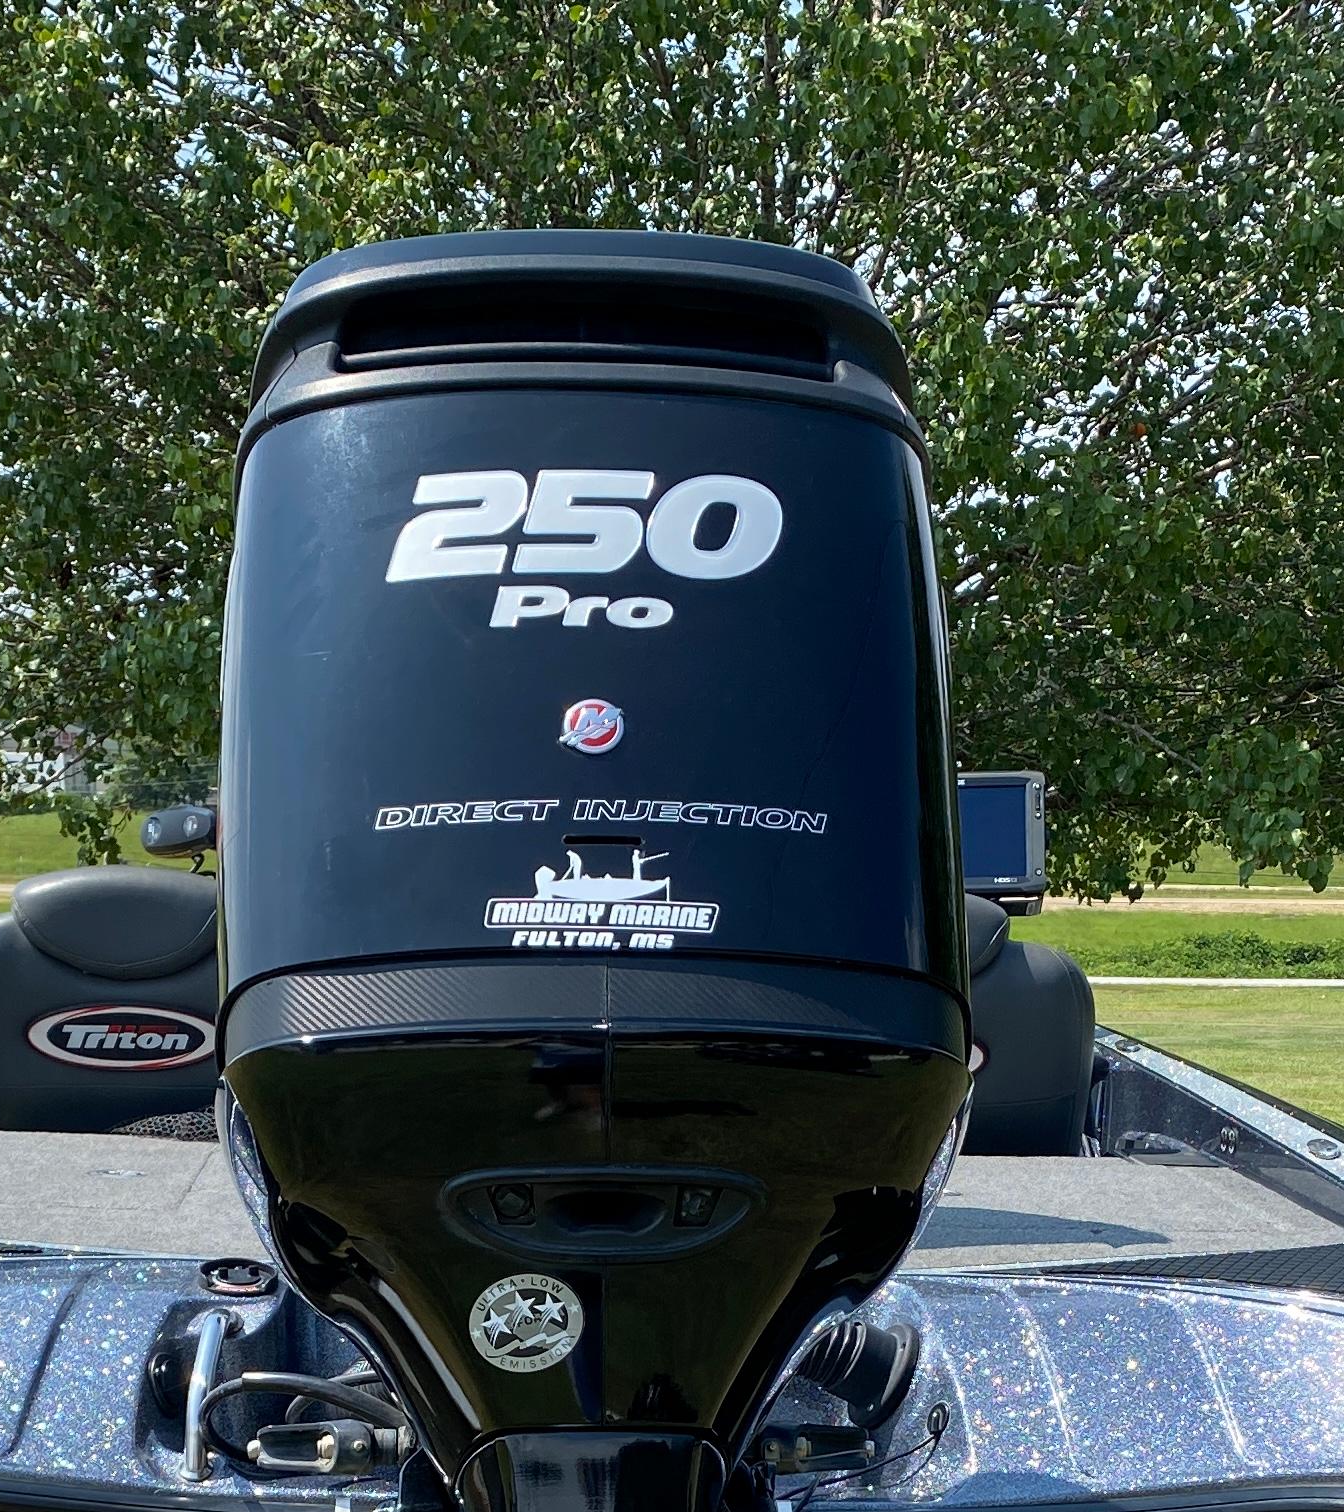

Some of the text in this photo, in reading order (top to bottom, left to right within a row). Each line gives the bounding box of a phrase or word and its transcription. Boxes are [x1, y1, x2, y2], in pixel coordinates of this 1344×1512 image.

[386, 470, 783, 583] 250
[489, 585, 674, 628] Pro
[374, 800, 827, 833] DIRECT INJECTION
[492, 903, 712, 929] MIDWAY MARINE
[512, 931, 675, 950] FULTON, MS
[62, 1024, 189, 1050] Triton
[476, 1276, 564, 1312] ULTRA LOW
[500, 1340, 572, 1369] EMISSION
